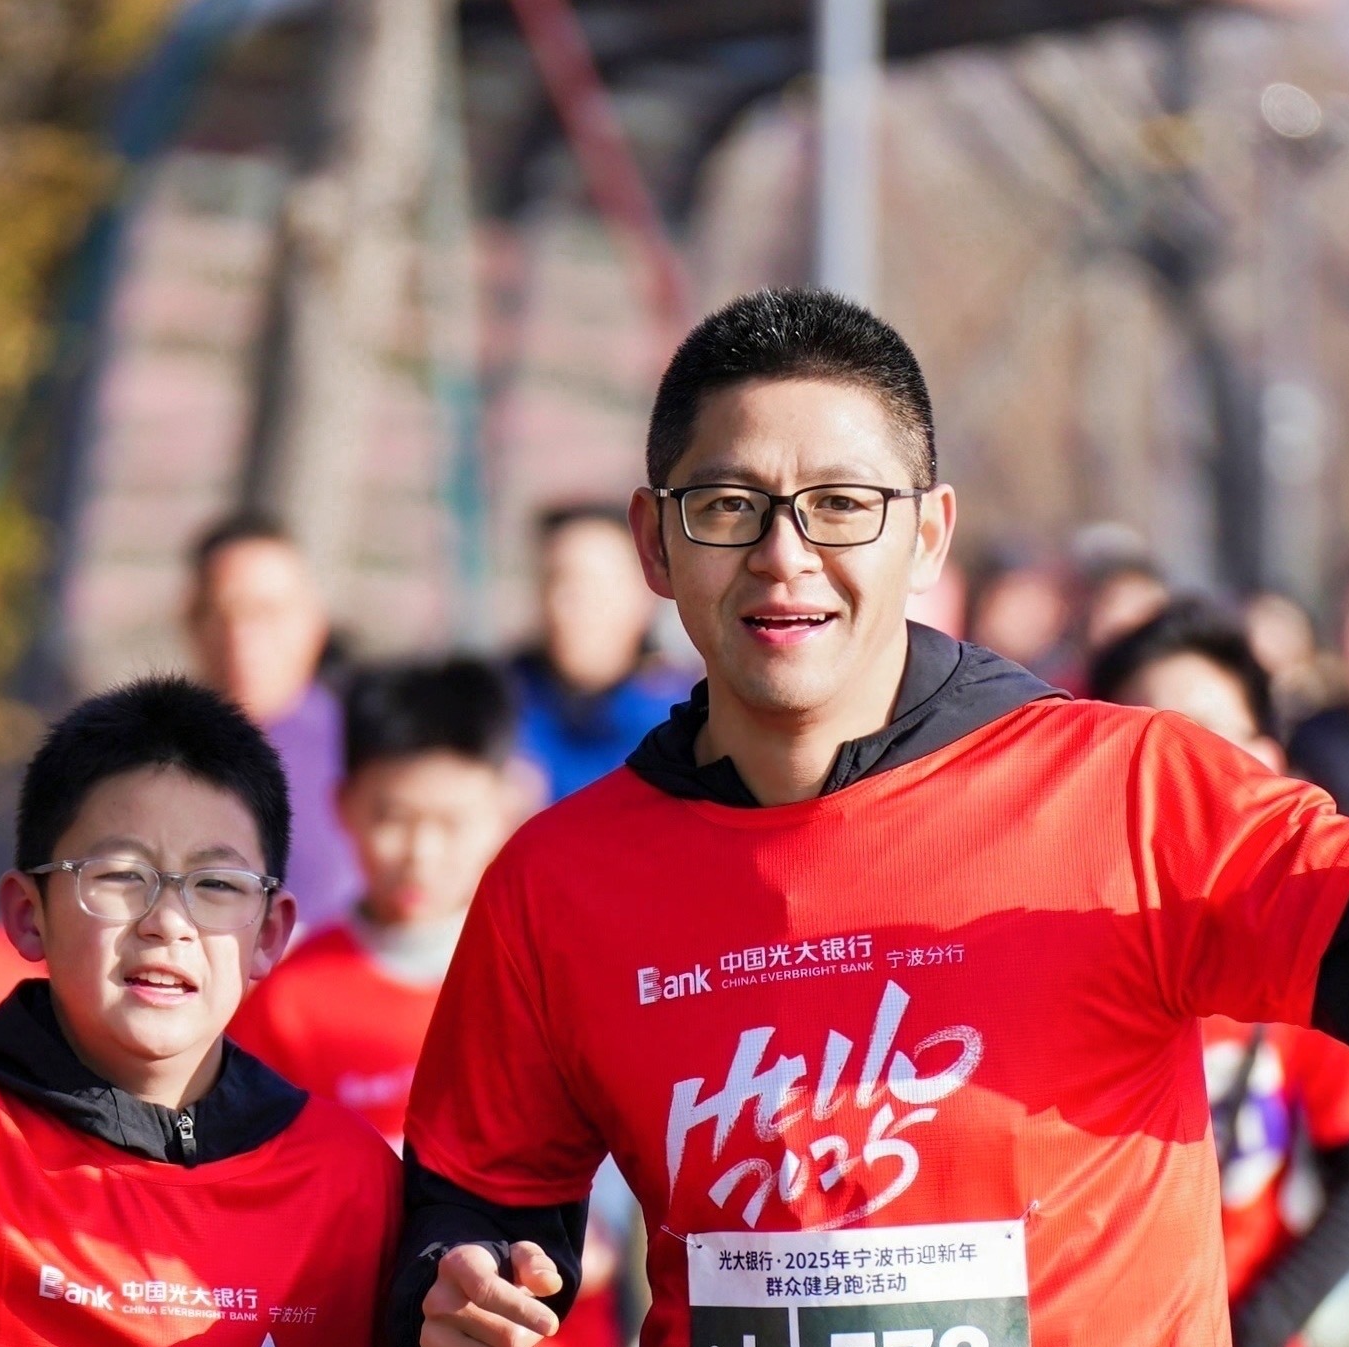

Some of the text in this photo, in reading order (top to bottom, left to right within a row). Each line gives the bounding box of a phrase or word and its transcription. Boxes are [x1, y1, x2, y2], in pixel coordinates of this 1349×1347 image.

[720, 934, 873, 974] 中国光大银行
[886, 944, 965, 969] 宁波分行
[721, 961, 874, 989] CHINA EVERBRIGHT BANK
[707, 1103, 938, 1232] 2025
[122, 1281, 258, 1310] 中国光大银行
[766, 1273, 907, 1297] 群众健身跑活动
[122, 1305, 258, 1321] CHINA EVERBRIGHT BANK
[268, 1306, 317, 1324] 宁波分行
